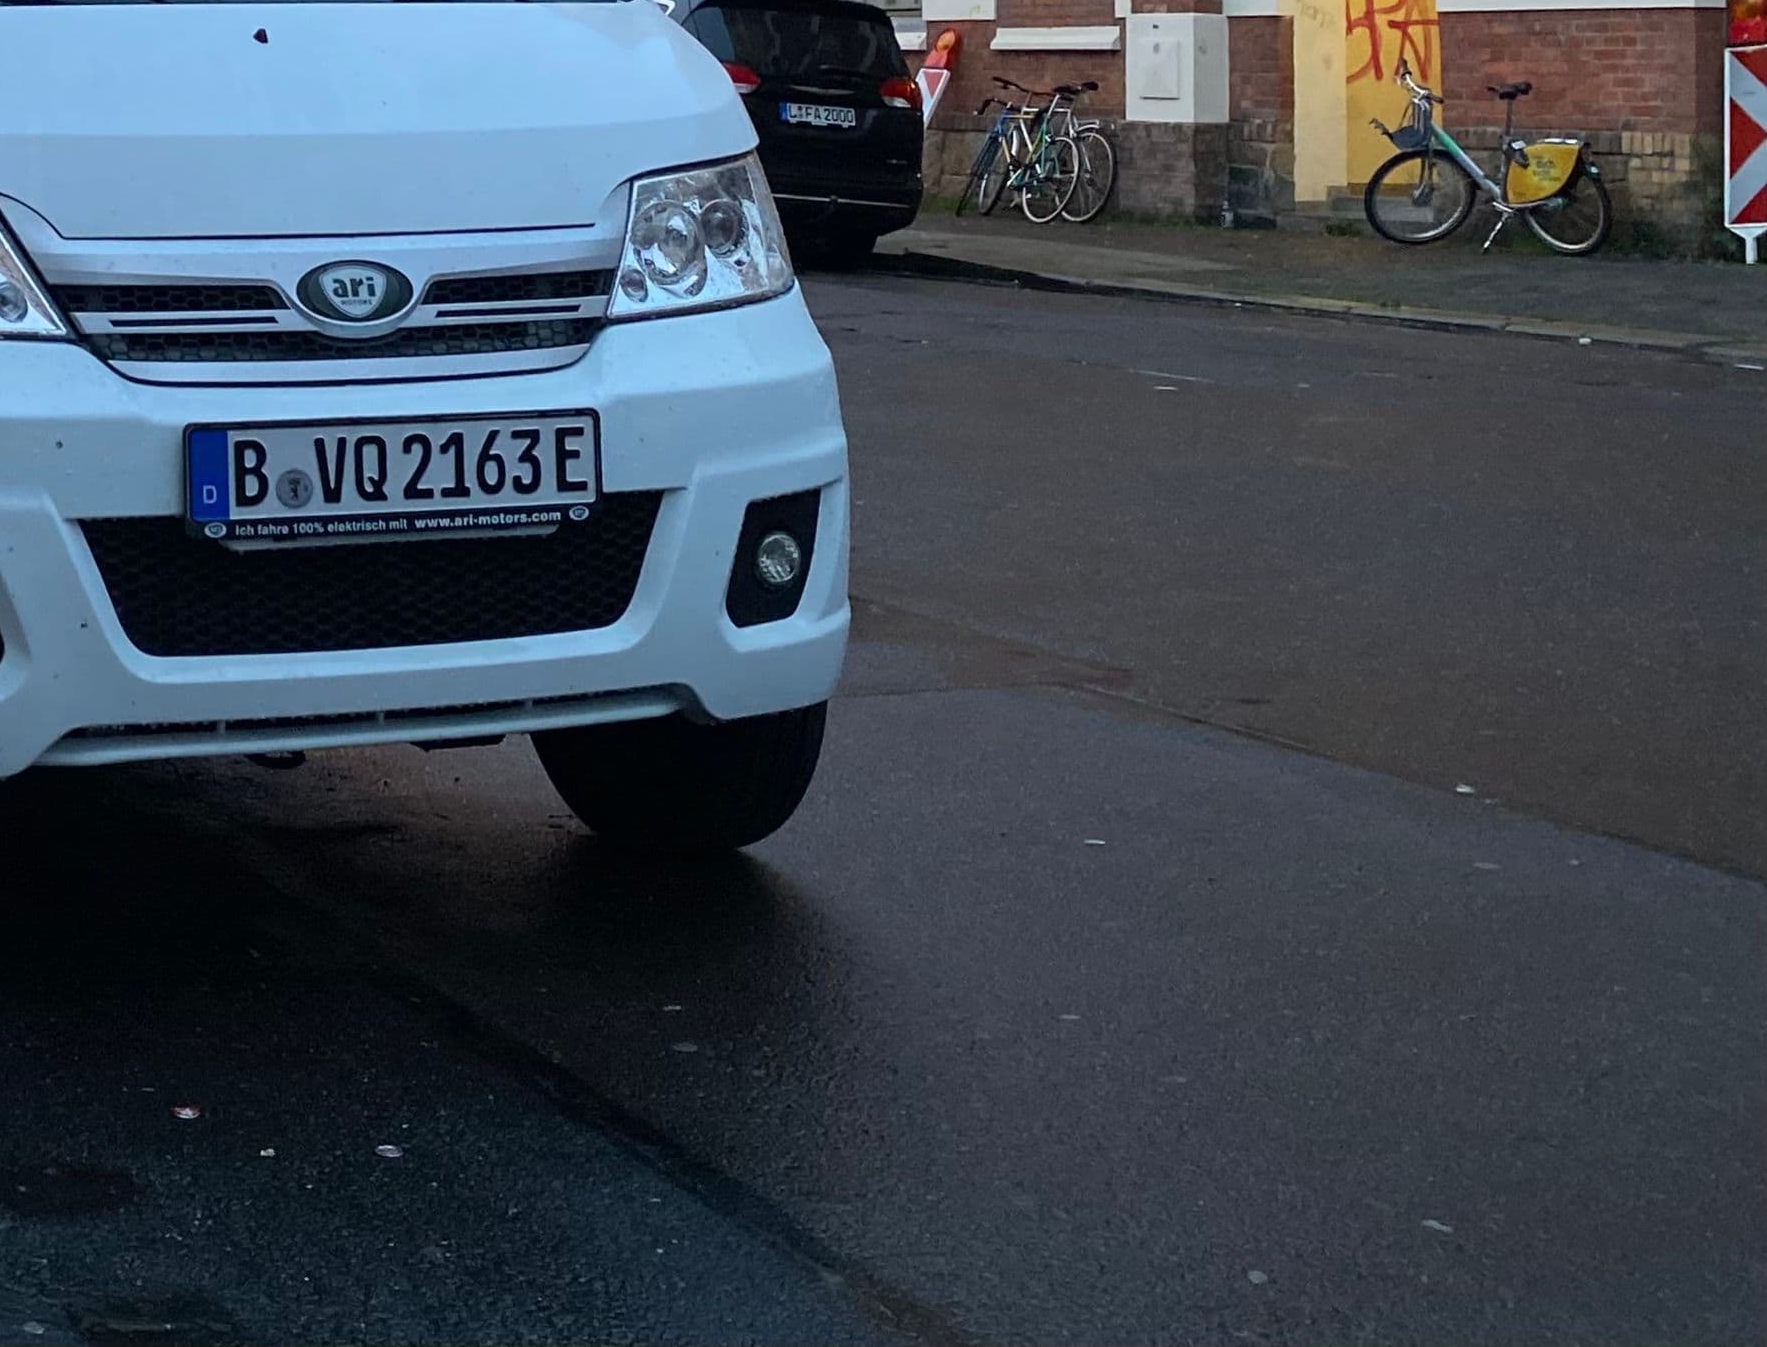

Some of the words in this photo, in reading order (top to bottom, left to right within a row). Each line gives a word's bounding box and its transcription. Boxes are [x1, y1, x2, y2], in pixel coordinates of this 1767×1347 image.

[824, 108, 853, 123] 2000
[332, 276, 377, 298] ari
[203, 485, 217, 504] D
[234, 439, 269, 507] B
[235, 525, 254, 535] Ich
[258, 524, 289, 535] fahre
[293, 522, 324, 534] 100%
[327, 519, 386, 532] elektrisch
[389, 518, 407, 530] mit
[414, 511, 561, 529] www.ari-motors.com
